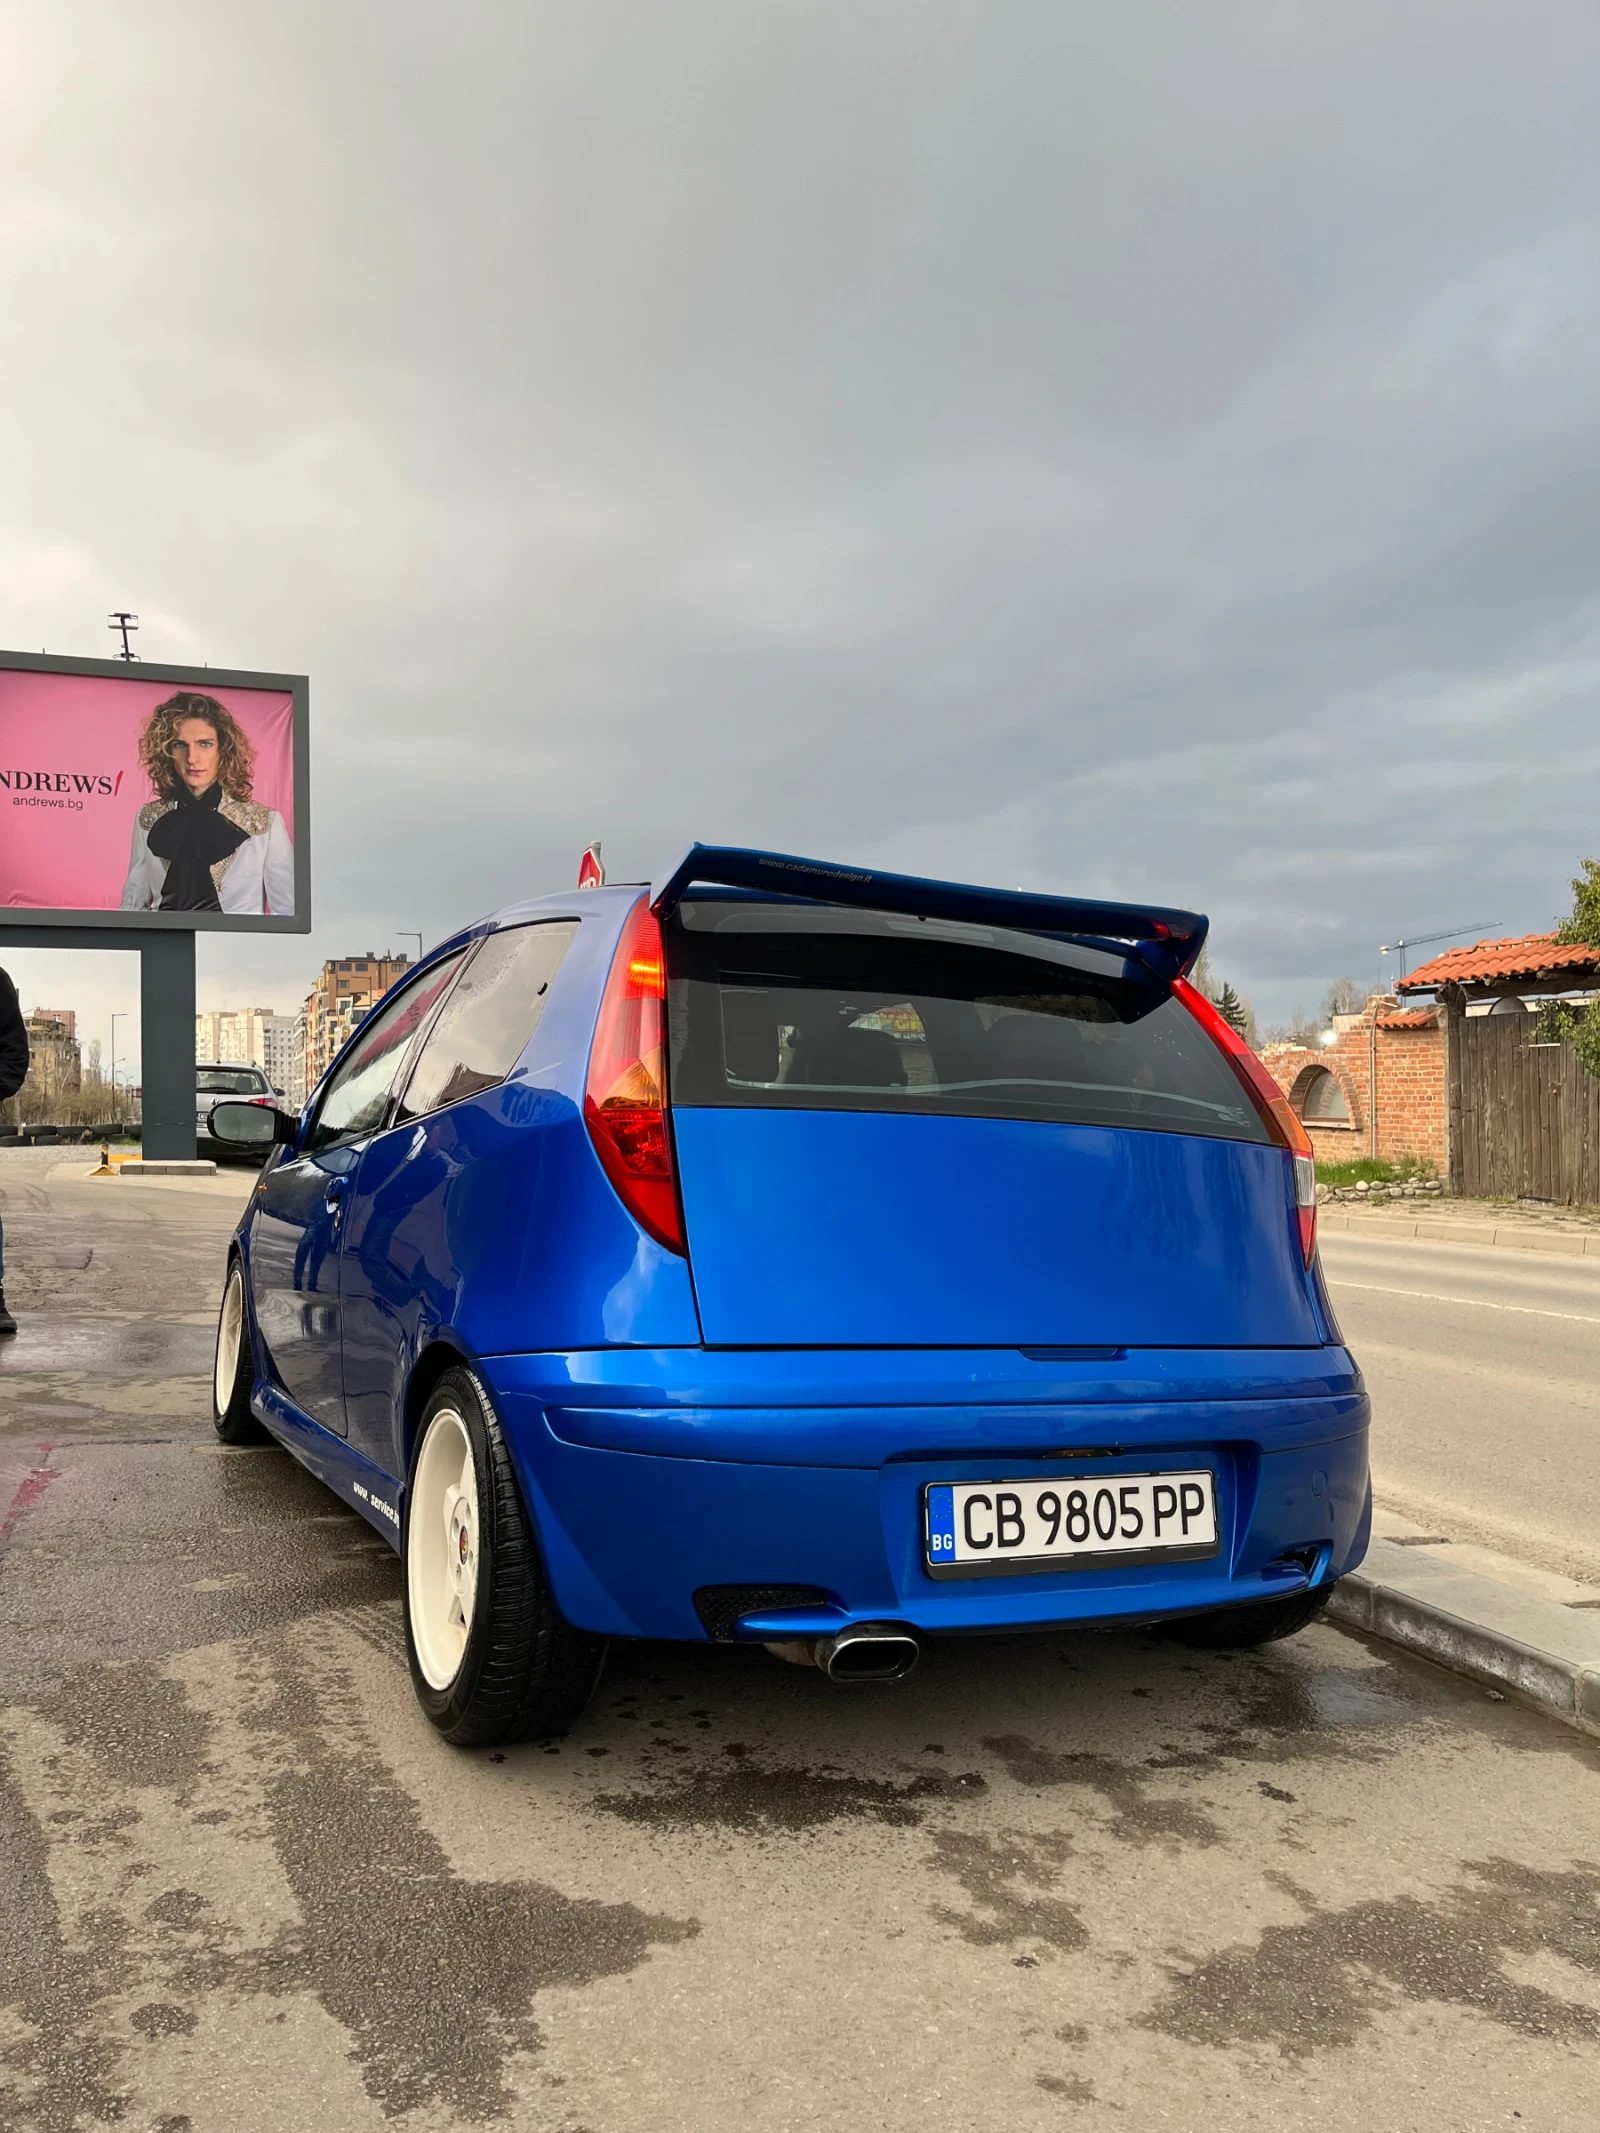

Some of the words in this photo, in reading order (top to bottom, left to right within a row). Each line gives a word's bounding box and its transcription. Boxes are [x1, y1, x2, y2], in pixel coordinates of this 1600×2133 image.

[13, 796, 84, 811] andrews.bg
[963, 1492, 1026, 1550] CB
[1036, 1486, 1144, 1546] 9805
[1152, 1483, 1205, 1538] PP
[932, 1534, 953, 1551] BG
